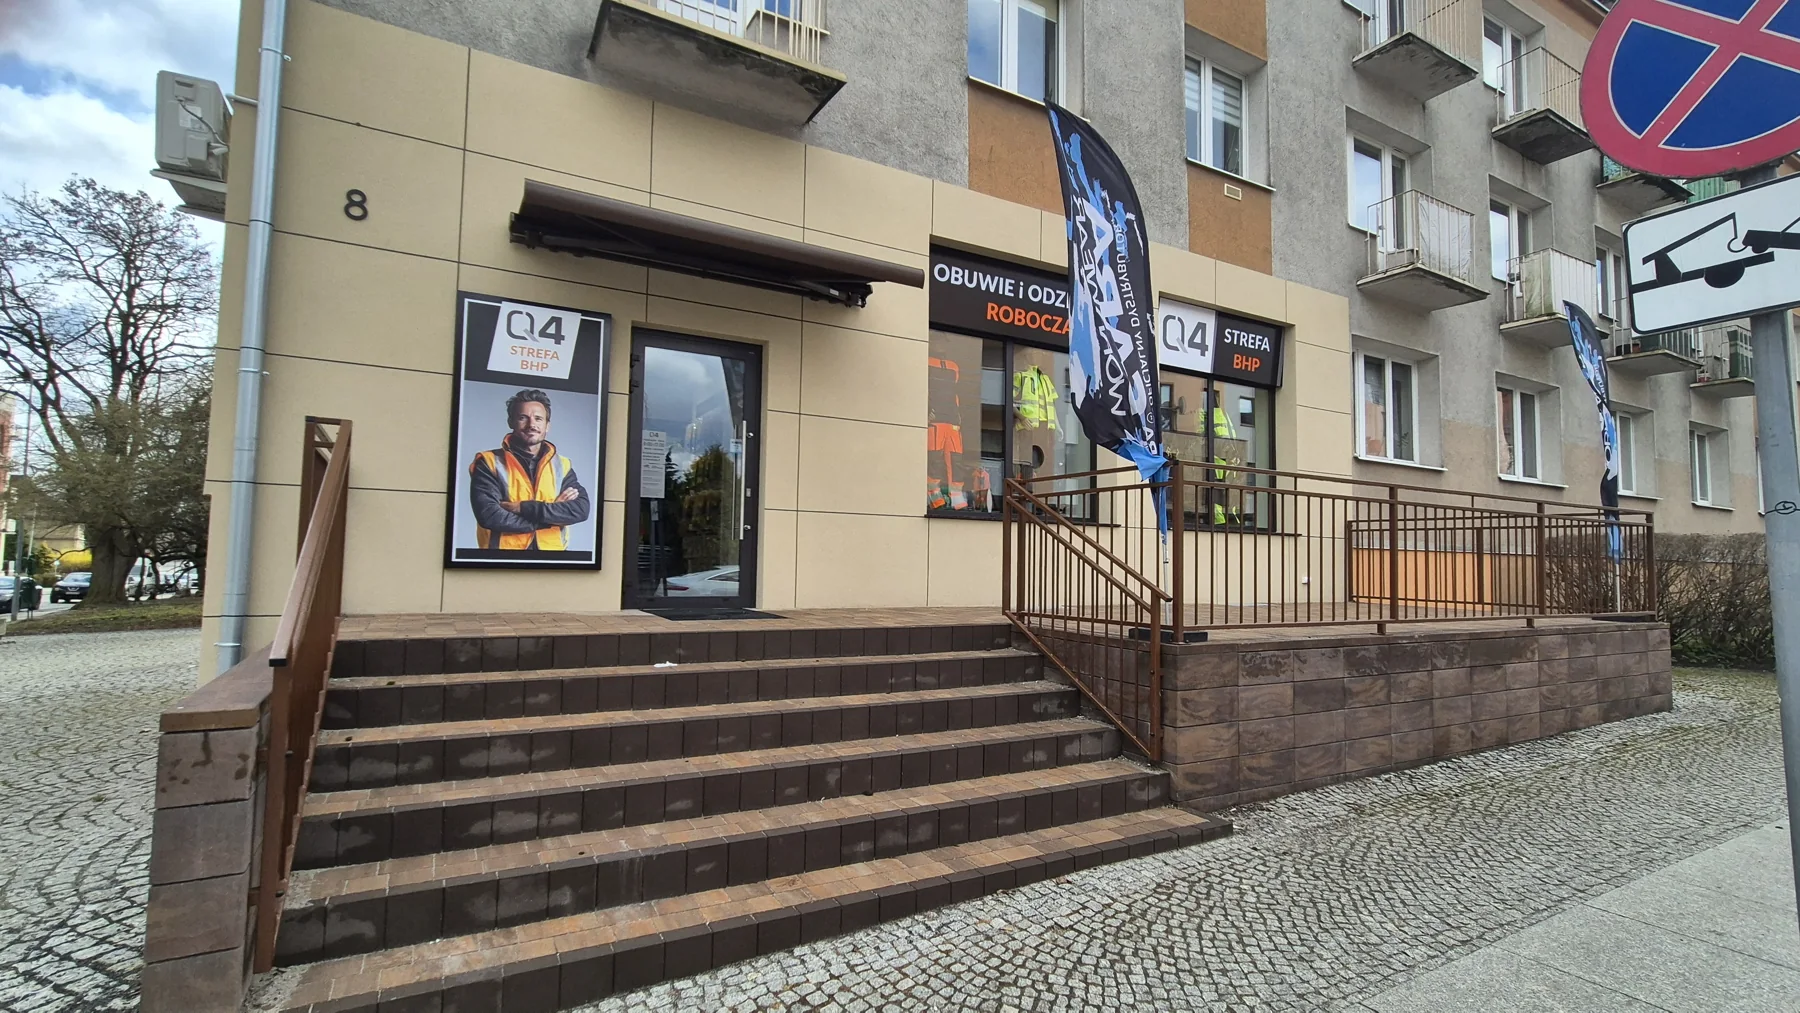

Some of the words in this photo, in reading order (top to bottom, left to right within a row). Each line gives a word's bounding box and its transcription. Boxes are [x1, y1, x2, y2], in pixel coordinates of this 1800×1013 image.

[344, 189, 368, 221] 8
[933, 263, 1015, 297] OBUWIE
[1018, 281, 1024, 299] i
[1028, 284, 1070, 309] ODZI
[506, 310, 565, 345] Q4
[986, 302, 1071, 335] ROBOCZA
[1162, 314, 1209, 357] Q4
[1224, 328, 1271, 352] STREFA
[510, 345, 560, 361] STREFA
[520, 360, 549, 372] BHP
[1233, 353, 1261, 372] BHP
